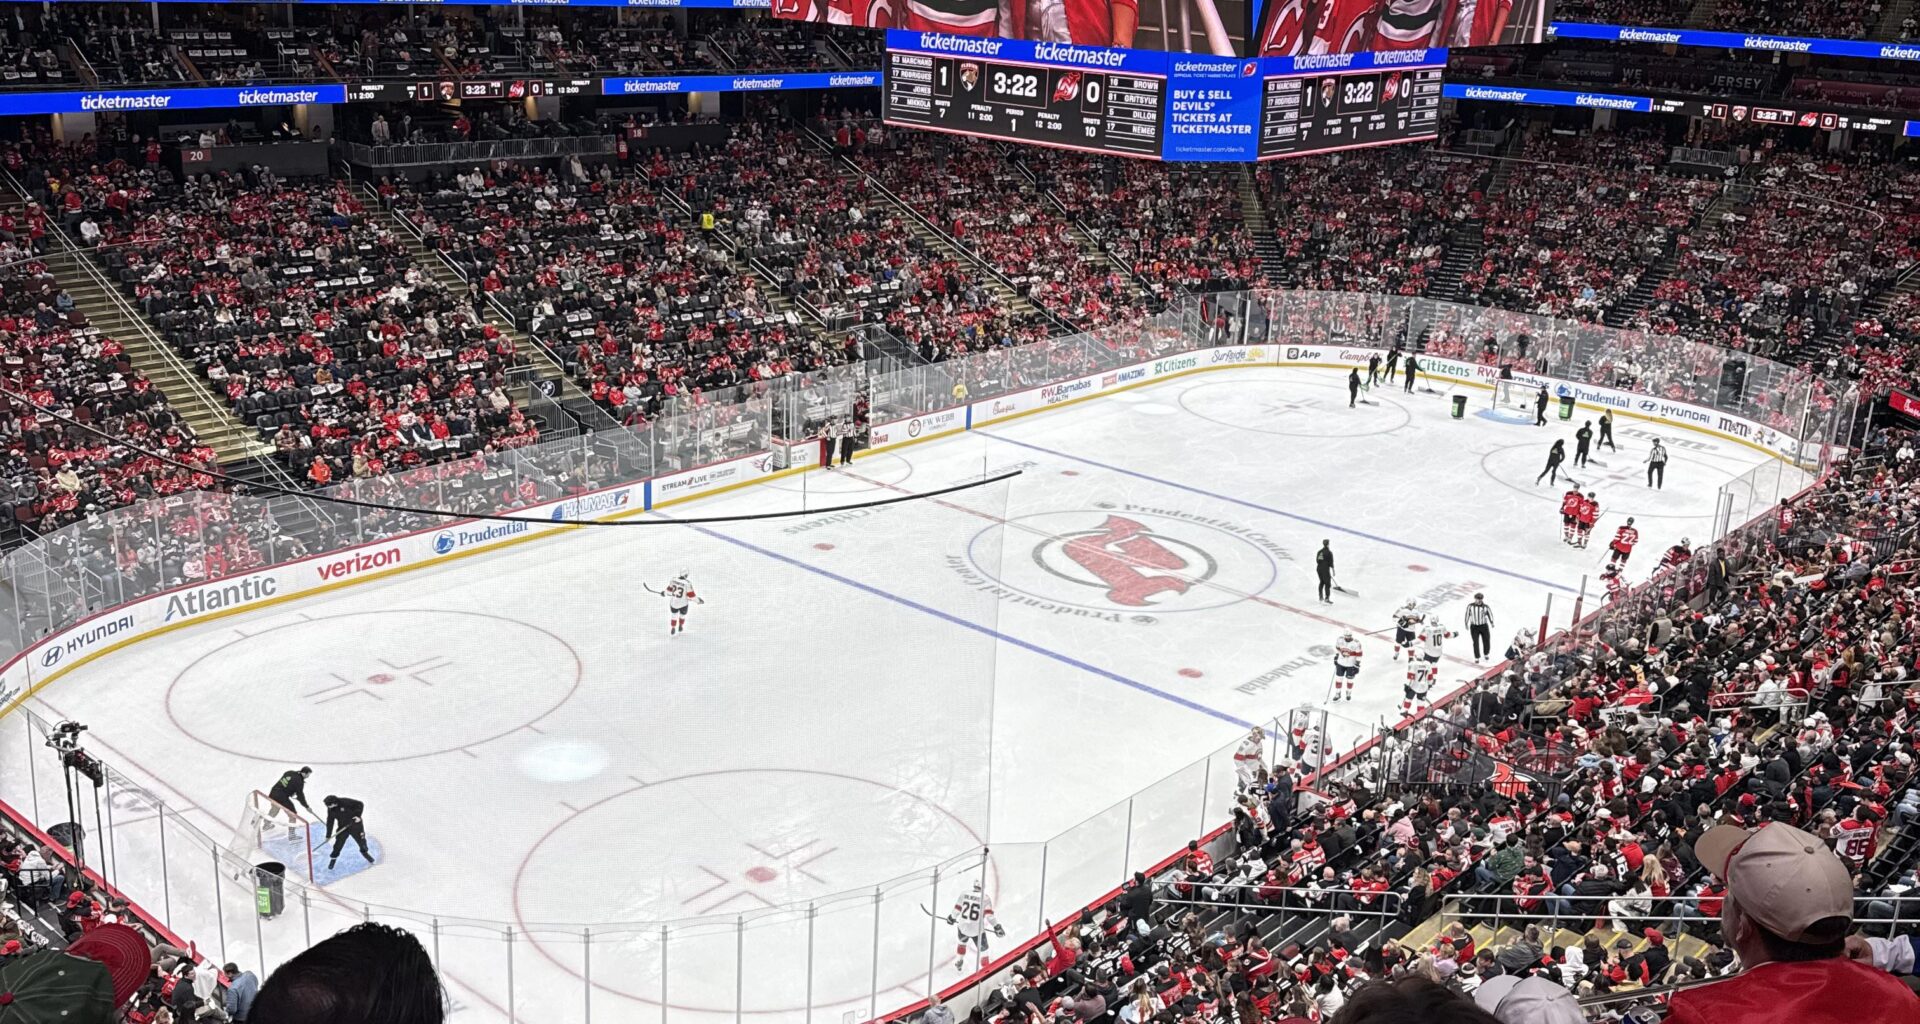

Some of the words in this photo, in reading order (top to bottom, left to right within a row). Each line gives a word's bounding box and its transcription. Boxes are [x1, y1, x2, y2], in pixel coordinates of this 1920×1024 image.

[1619, 28, 1681, 43] ticketmaster
[921, 32, 1002, 55] ticketmaster
[1744, 37, 1812, 51] ticketmaster
[1035, 42, 1127, 66] ticketmaster
[1373, 49, 1428, 65] ticketmaster
[902, 56, 932, 67] MARCHAND
[1174, 61, 1237, 72] ticketmaster
[1293, 53, 1355, 70] ticketmaster
[830, 75, 875, 86] ticketmaster
[900, 70, 932, 80] RODRIGUES
[940, 66, 947, 86] 1
[1622, 68, 1642, 80] WE
[1711, 75, 1762, 89] JERSEY
[465, 85, 486, 95] 3:22
[532, 84, 539, 94] 0
[566, 86, 579, 94] 2:00
[624, 80, 681, 92] ticketmaster
[733, 78, 783, 90] ticketmaster
[912, 85, 932, 94] JONES
[993, 72, 1038, 97] 3:22
[1133, 80, 1159, 90] BROWN
[1401, 78, 1411, 99] 0
[238, 89, 318, 105] ticketmaster
[359, 92, 374, 100] 2:00
[409, 91, 414, 99] 7
[423, 87, 428, 97] 1
[1086, 81, 1100, 103] 0
[1173, 90, 1196, 99] BUY
[1198, 90, 1205, 99] &
[1208, 90, 1232, 99] SELL
[1306, 86, 1313, 107] 1
[1344, 82, 1374, 104] 3:22
[1465, 87, 1527, 101] ticketmaster
[80, 94, 171, 110] ticketmaster
[906, 98, 931, 108] MIKKOLA
[1124, 94, 1158, 105] GRITSYUK
[1576, 94, 1637, 109] ticketmaster
[939, 108, 946, 118] 7
[979, 112, 993, 121] 2:00
[1037, 112, 1060, 120] PENALTY
[1132, 110, 1157, 121] DILLON
[1172, 113, 1216, 122] TICKETS
[1218, 113, 1232, 122] AT
[1717, 107, 1723, 116] 1
[1756, 111, 1777, 121] 3:22
[1011, 118, 1016, 132] 1
[1047, 121, 1062, 130] 2:00
[1824, 117, 1832, 126] 0
[633, 129, 642, 137] 18
[1085, 126, 1096, 137] 10
[1106, 122, 1116, 131] 17
[1132, 125, 1156, 135] NEMEC
[1171, 124, 1252, 134] TICKETMASTER
[190, 151, 203, 161] 20
[1211, 349, 1246, 363] Surfside
[1164, 357, 1197, 373] Citizens
[1418, 358, 1471, 377] Citizens
[1118, 368, 1145, 382] AMAZING
[1048, 394, 1068, 404] HEALTH
[1575, 388, 1630, 409] Prudential
[935, 413, 955, 425] WEBB
[1661, 405, 1710, 424] HYUNDAI
[662, 480, 688, 491] STREAM
[694, 475, 707, 484] LIVE
[562, 492, 616, 519] HALMAR
[459, 520, 529, 546] Prudential
[1621, 533, 1636, 545] 22
[317, 547, 401, 581] verizon
[672, 585, 684, 598] 23
[165, 575, 277, 622] Atlantic
[67, 615, 134, 654] HYUNDAI
[1433, 634, 1442, 646] 10
[1845, 839, 1869, 857] 86
[961, 901, 980, 921] 26
